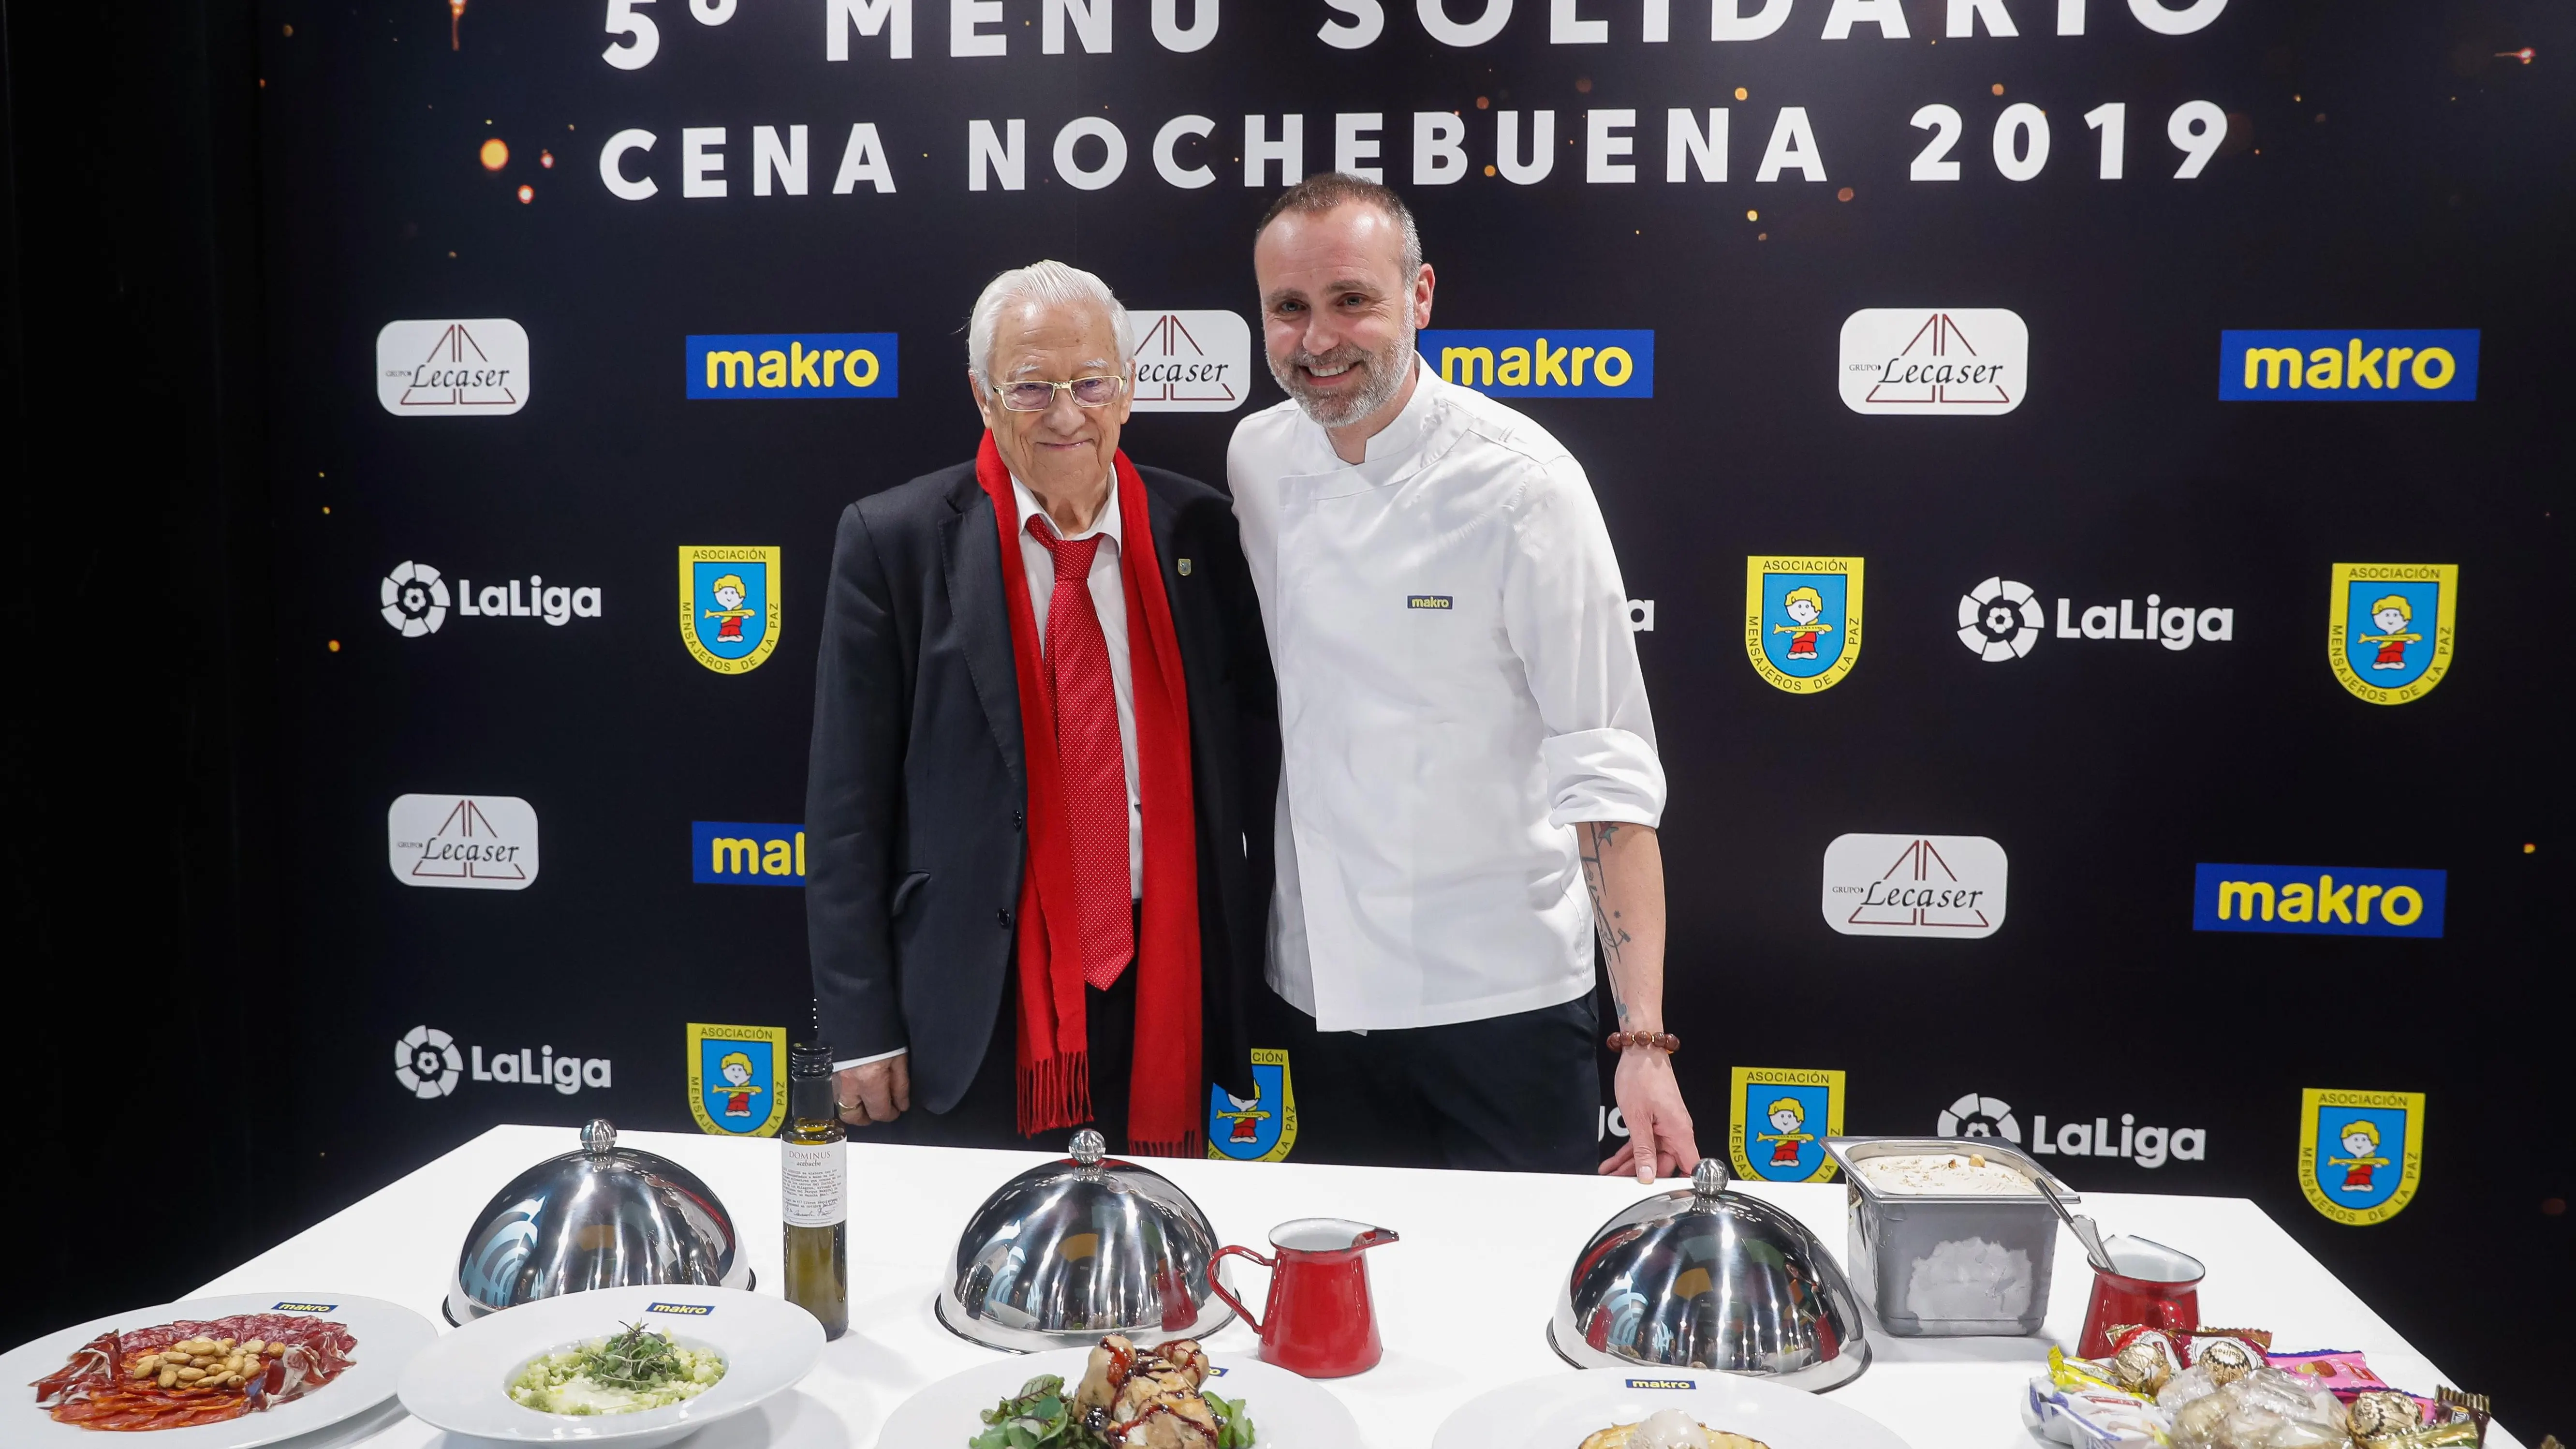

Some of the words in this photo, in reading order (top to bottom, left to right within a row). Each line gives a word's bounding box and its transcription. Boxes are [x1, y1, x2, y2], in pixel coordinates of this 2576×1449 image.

[600, 122, 897, 200] CENA
[968, 106, 1828, 190] NOCHEBUENA
[1910, 100, 2228, 180] 2019
[410, 362, 510, 387] Lecaser
[707, 341, 879, 388] makro
[1132, 363, 1229, 382] ecaser
[1442, 338, 1634, 386] makro
[1879, 357, 2003, 384] Lecaser
[2245, 339, 2456, 388] makro
[693, 548, 767, 560] ASOCIACIÓN
[1763, 559, 1848, 572] ASOCIACIÓN
[2349, 567, 2441, 579] ASOCIACIÓN
[459, 575, 601, 626] LaLiga
[1412, 596, 1449, 608] makro
[2056, 593, 2234, 647] LaLiga
[682, 602, 731, 671] MENSAJEROS
[740, 656, 757, 670] DE
[762, 633, 775, 653] LA
[770, 602, 779, 628] PAZ
[1749, 615, 1802, 690] MENSAJEROS
[1813, 674, 1833, 687] DE
[1839, 652, 1854, 673] LA
[1849, 616, 1860, 645] PAZ
[2332, 624, 2387, 703] MENSAJEROS
[2401, 683, 2421, 700] DE
[2428, 665, 2444, 682] LA
[2440, 626, 2452, 655] PAZ
[421, 837, 519, 863] Lecaser
[1860, 881, 1983, 909] Lecaser
[2218, 875, 2423, 925] makro
[701, 1027, 773, 1039] ASOCIACIÓN
[471, 1046, 612, 1094] LaLiga
[1746, 1070, 1829, 1083] ASOCIACIÓN
[769, 1115, 781, 1129] LA
[776, 1080, 785, 1106] PAZ
[2318, 1093, 2408, 1107] ASOCIACIÓN
[1275, 1139, 1291, 1155] LA
[1286, 1106, 1295, 1131] PAZ
[2032, 1115, 2206, 1167] LaLiga
[789, 1151, 831, 1159] DOMINUS
[1819, 1164, 1834, 1179] LA
[2302, 1147, 2356, 1222] MENSAJEROS
[2369, 1207, 2387, 1221] DE
[2396, 1184, 2412, 1205] LA
[2406, 1152, 2418, 1182] PAZ
[279, 1303, 330, 1312] makro
[653, 1303, 707, 1314] makro
[1632, 1380, 1691, 1389] makro
